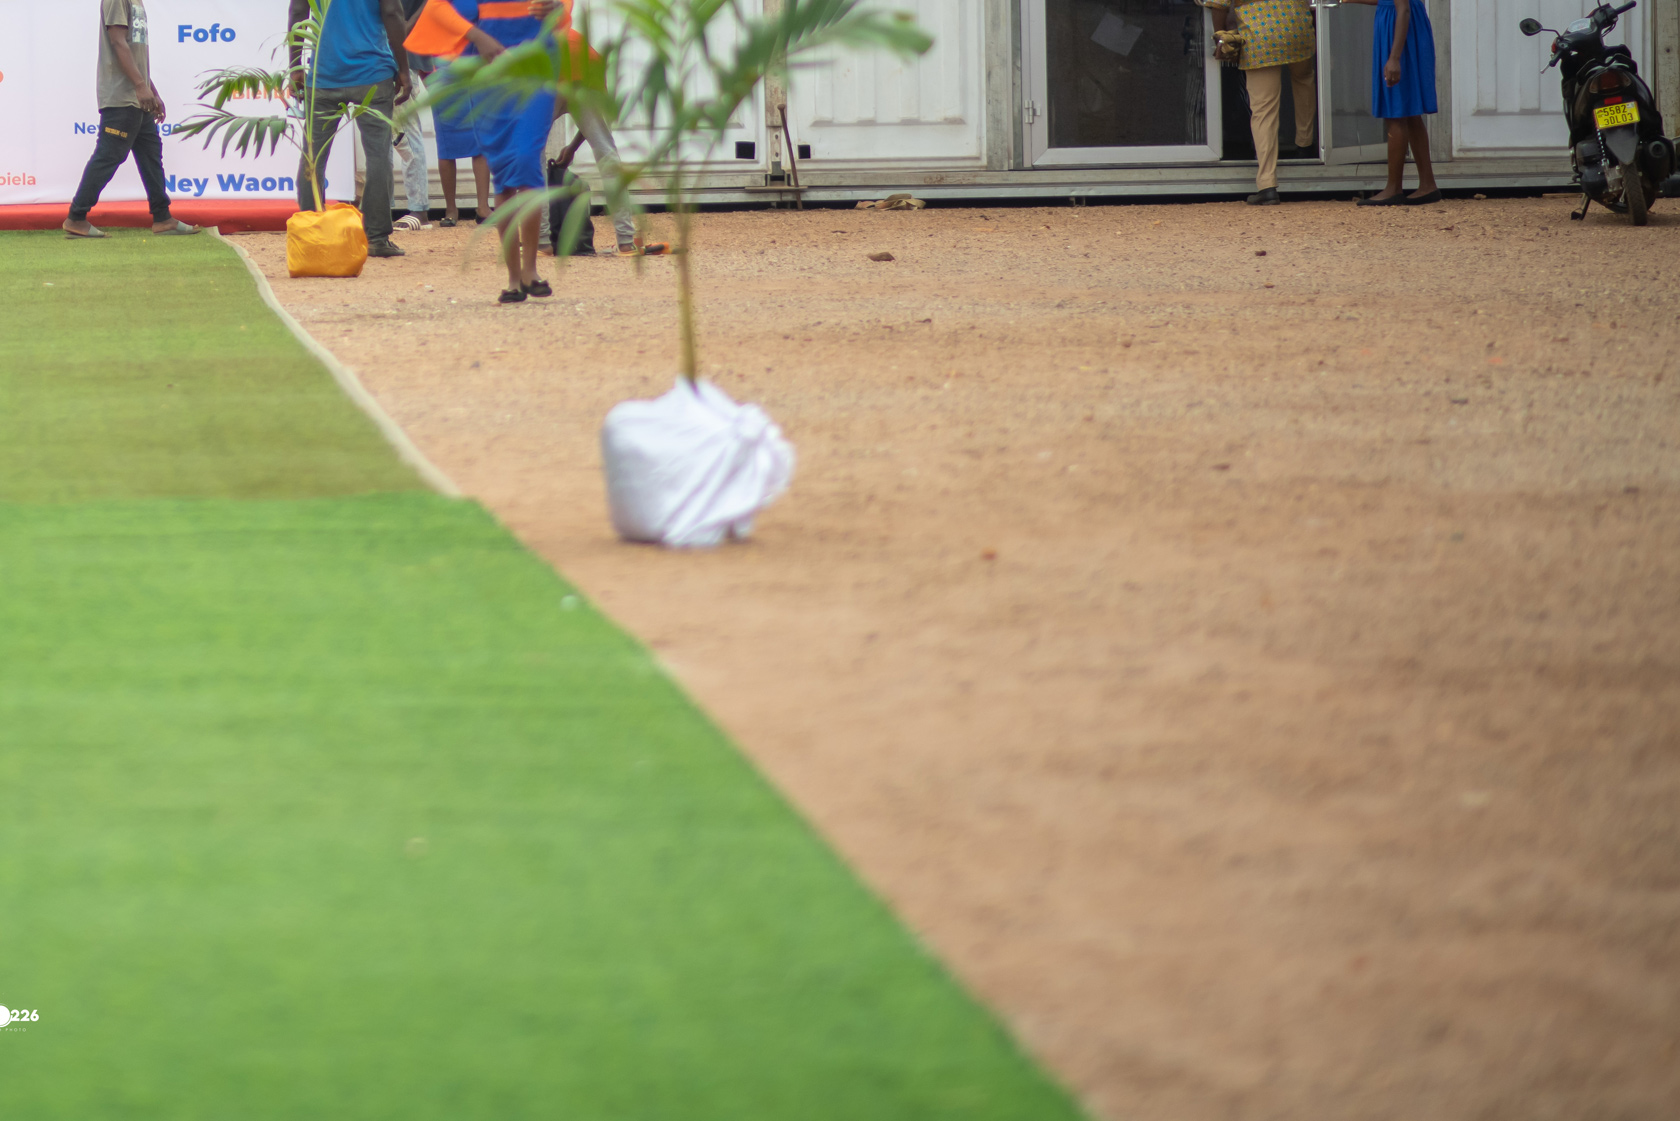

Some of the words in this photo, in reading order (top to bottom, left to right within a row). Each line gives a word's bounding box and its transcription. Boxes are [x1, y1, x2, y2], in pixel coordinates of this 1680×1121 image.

[177, 22, 236, 43] Fofo
[1603, 105, 1627, 116] 5582
[165, 174, 209, 197] Ney
[216, 173, 330, 192] Waon
